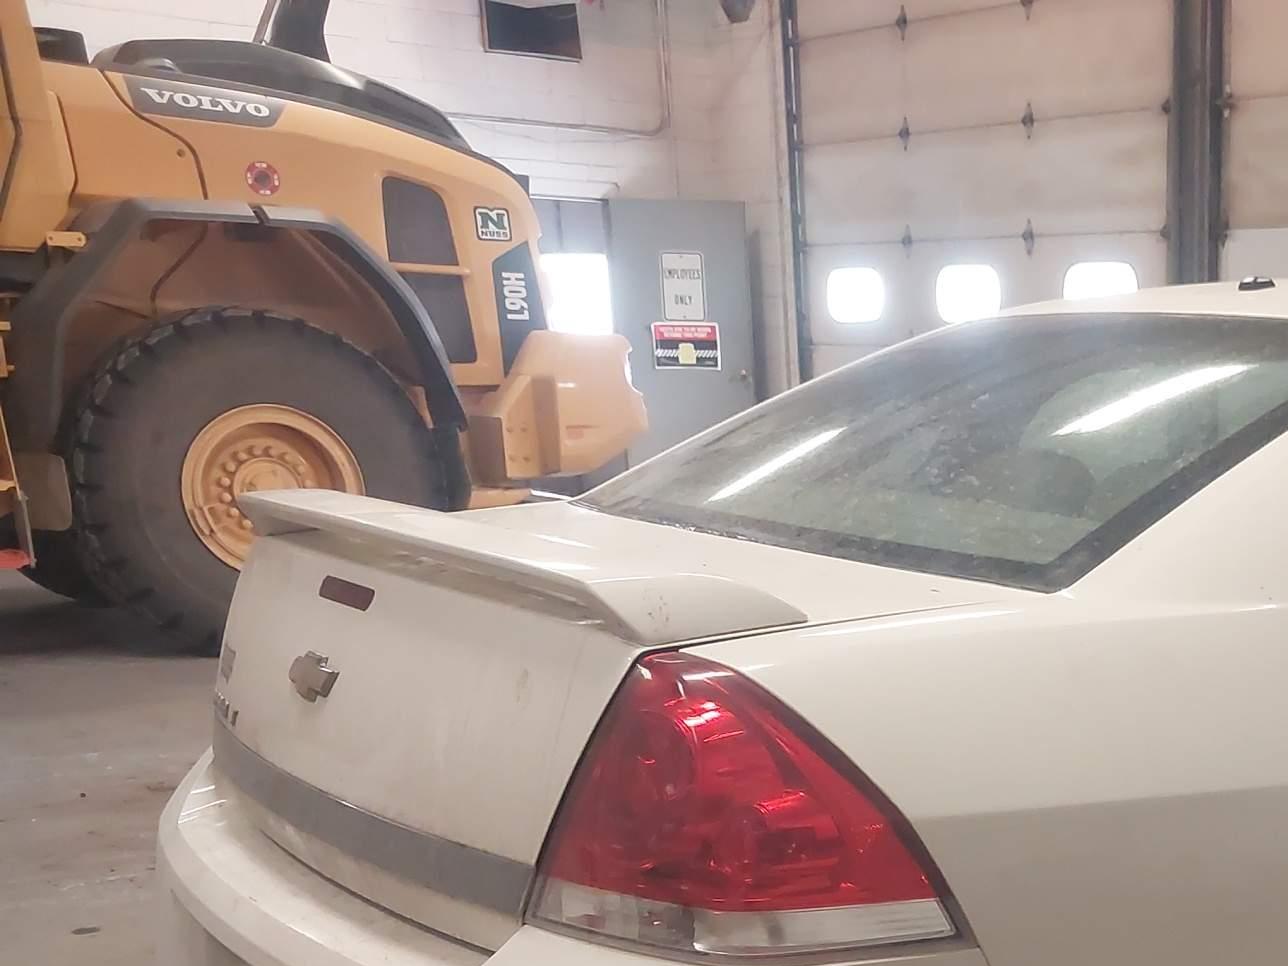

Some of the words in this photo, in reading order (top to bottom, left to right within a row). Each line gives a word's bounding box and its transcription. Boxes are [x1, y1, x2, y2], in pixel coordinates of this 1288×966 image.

[140, 87, 270, 117] VOLVO
[478, 211, 508, 231] N
[664, 268, 701, 280] EMPLOYEES
[502, 272, 530, 320] L90H
[674, 294, 692, 305] ONLY
